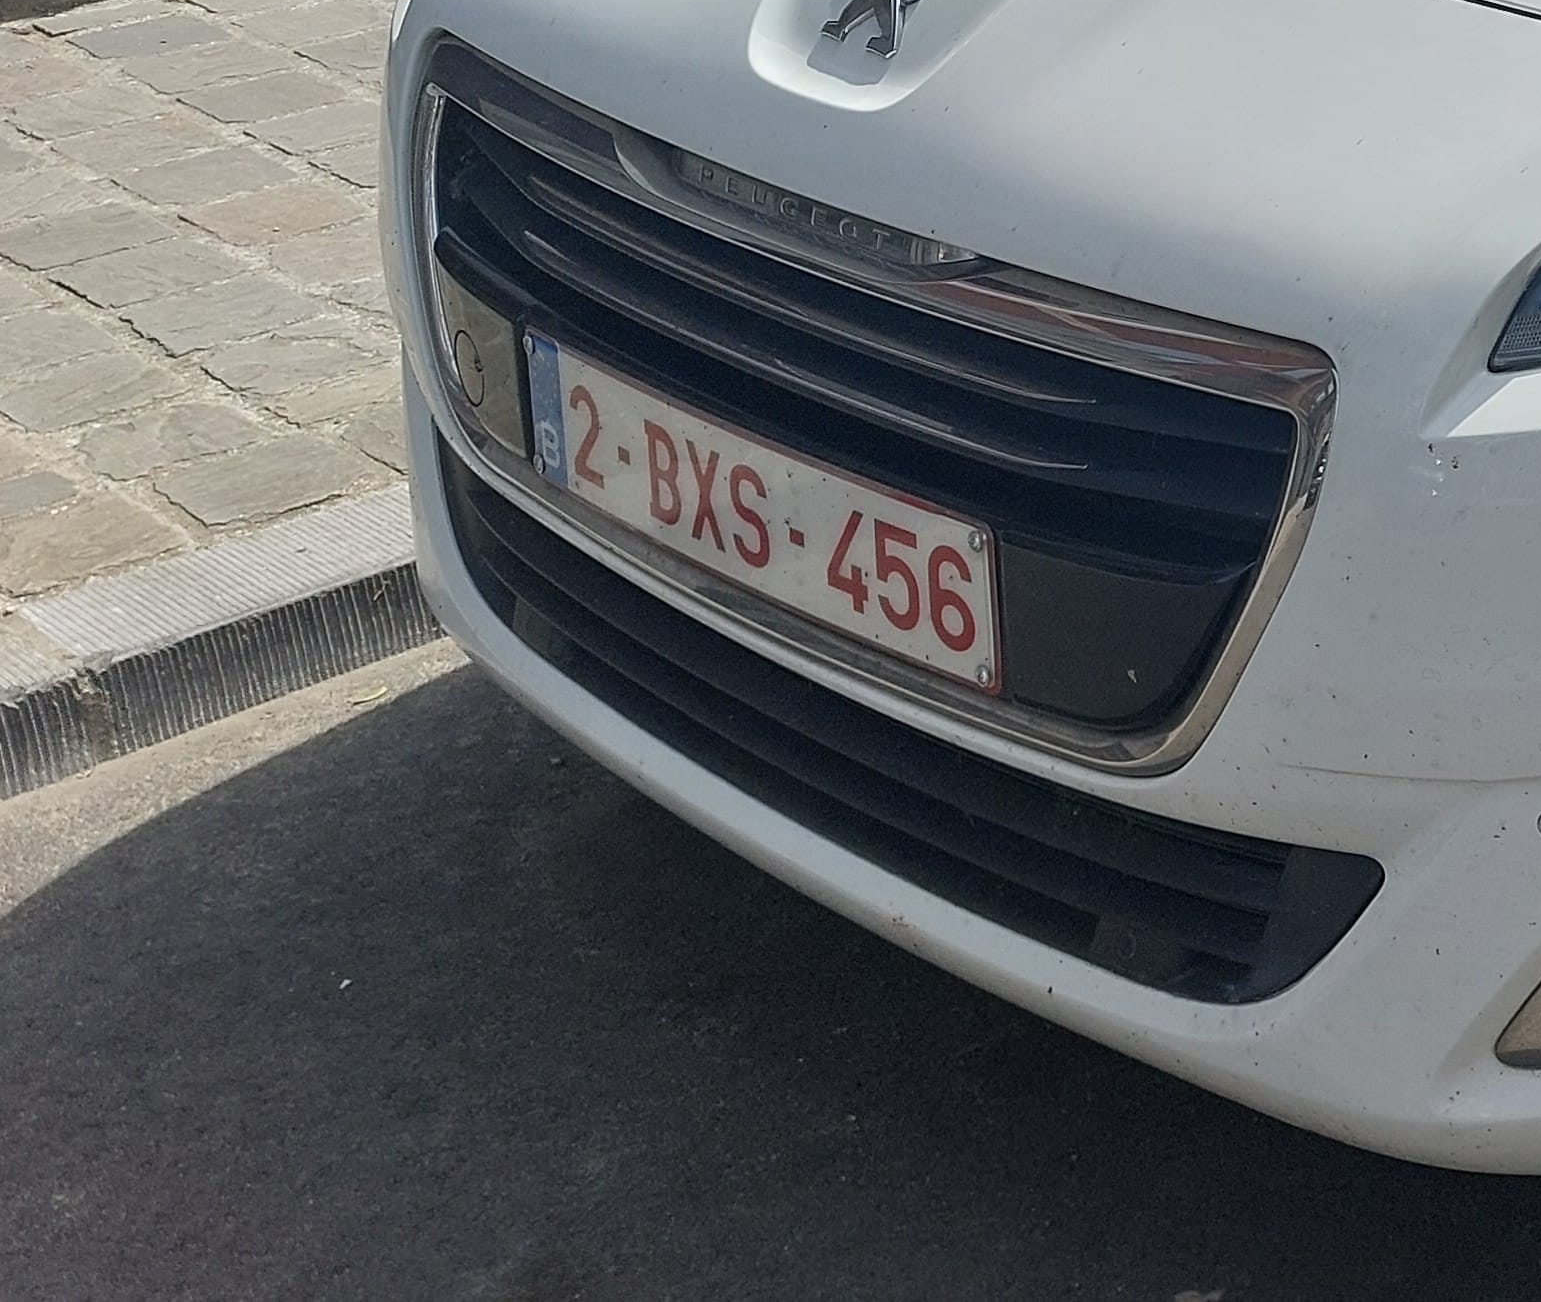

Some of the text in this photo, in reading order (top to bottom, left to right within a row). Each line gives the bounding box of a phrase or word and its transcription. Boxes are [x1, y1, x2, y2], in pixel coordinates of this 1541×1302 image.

[699, 165, 891, 251] PEUGEOT
[540, 420, 561, 469] B
[569, 384, 976, 653] 2-BXS-456
